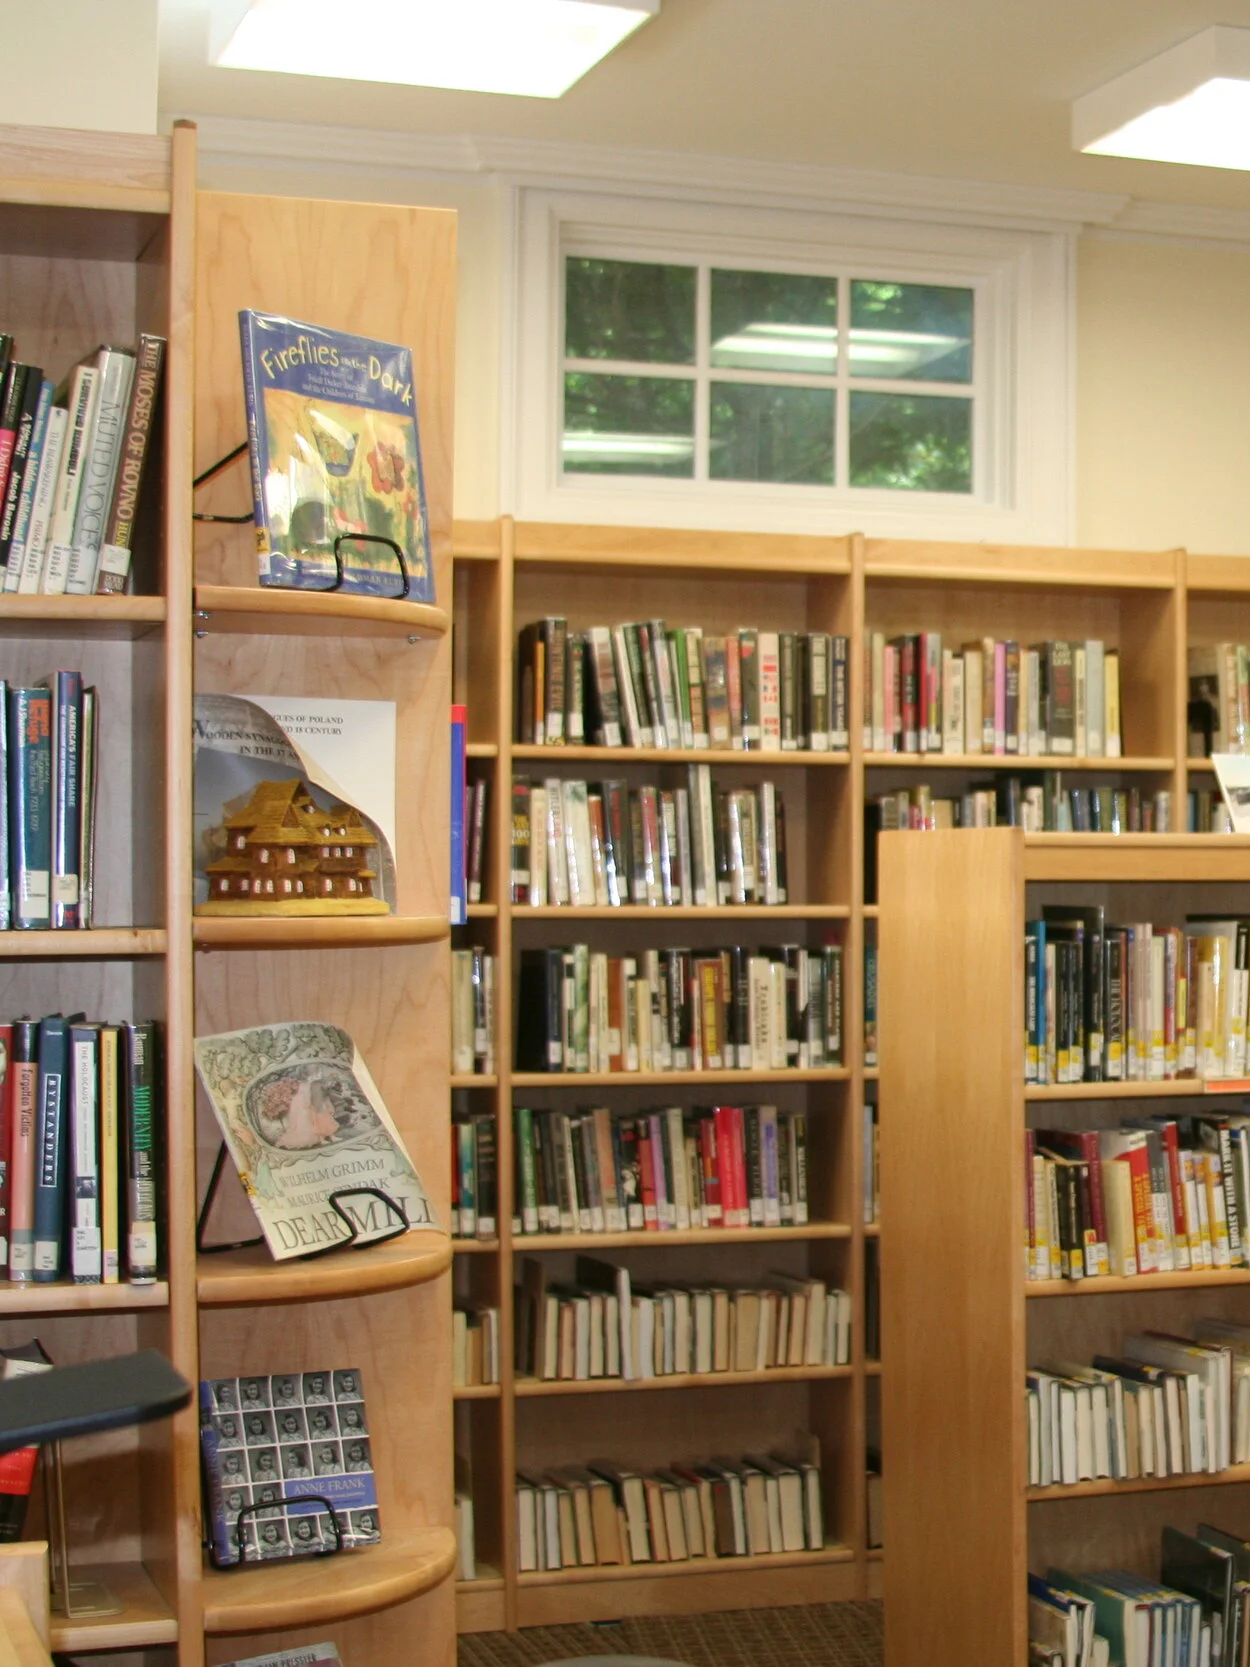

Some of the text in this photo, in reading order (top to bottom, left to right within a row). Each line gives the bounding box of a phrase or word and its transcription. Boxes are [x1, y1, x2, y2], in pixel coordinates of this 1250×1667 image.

[260, 335, 339, 379] Fireflies
[368, 355, 413, 407] Dark
[115, 343, 158, 548] THE MOSES OF ROVNO HUN
[23, 459, 38, 490] hidden
[81, 402, 120, 550] MUTED VOICES
[1, 472, 22, 541] Jacob Barosin
[273, 714, 344, 724] GUES OF POLAND
[304, 727, 342, 735] CENTURY
[68, 705, 77, 808] AMERICA'S FAIR SHARE
[239, 746, 251, 755] IN
[255, 747, 274, 757] THE
[1111, 998, 1121, 1042] HOLOCAU
[81, 1046, 89, 1060] THE
[20, 1069, 32, 1137] Forgotten Victims
[81, 1062, 89, 1104] HOLOCAUST
[44, 1079, 57, 1182] BYSTANDERS
[133, 1085, 151, 1150] MODERNITY
[139, 1152, 149, 1164] and
[279, 1158, 385, 1189] WILHELM GRIMM
[136, 1178, 153, 1220] HOLOCAUS
[286, 1189, 331, 1208] MAURICE
[1220, 1130, 1241, 1248] MARK IT WITH A STONE
[272, 1196, 435, 1250] DEAR MILI
[293, 1482, 325, 1495] ANNE
[328, 1477, 366, 1492] FRANK
